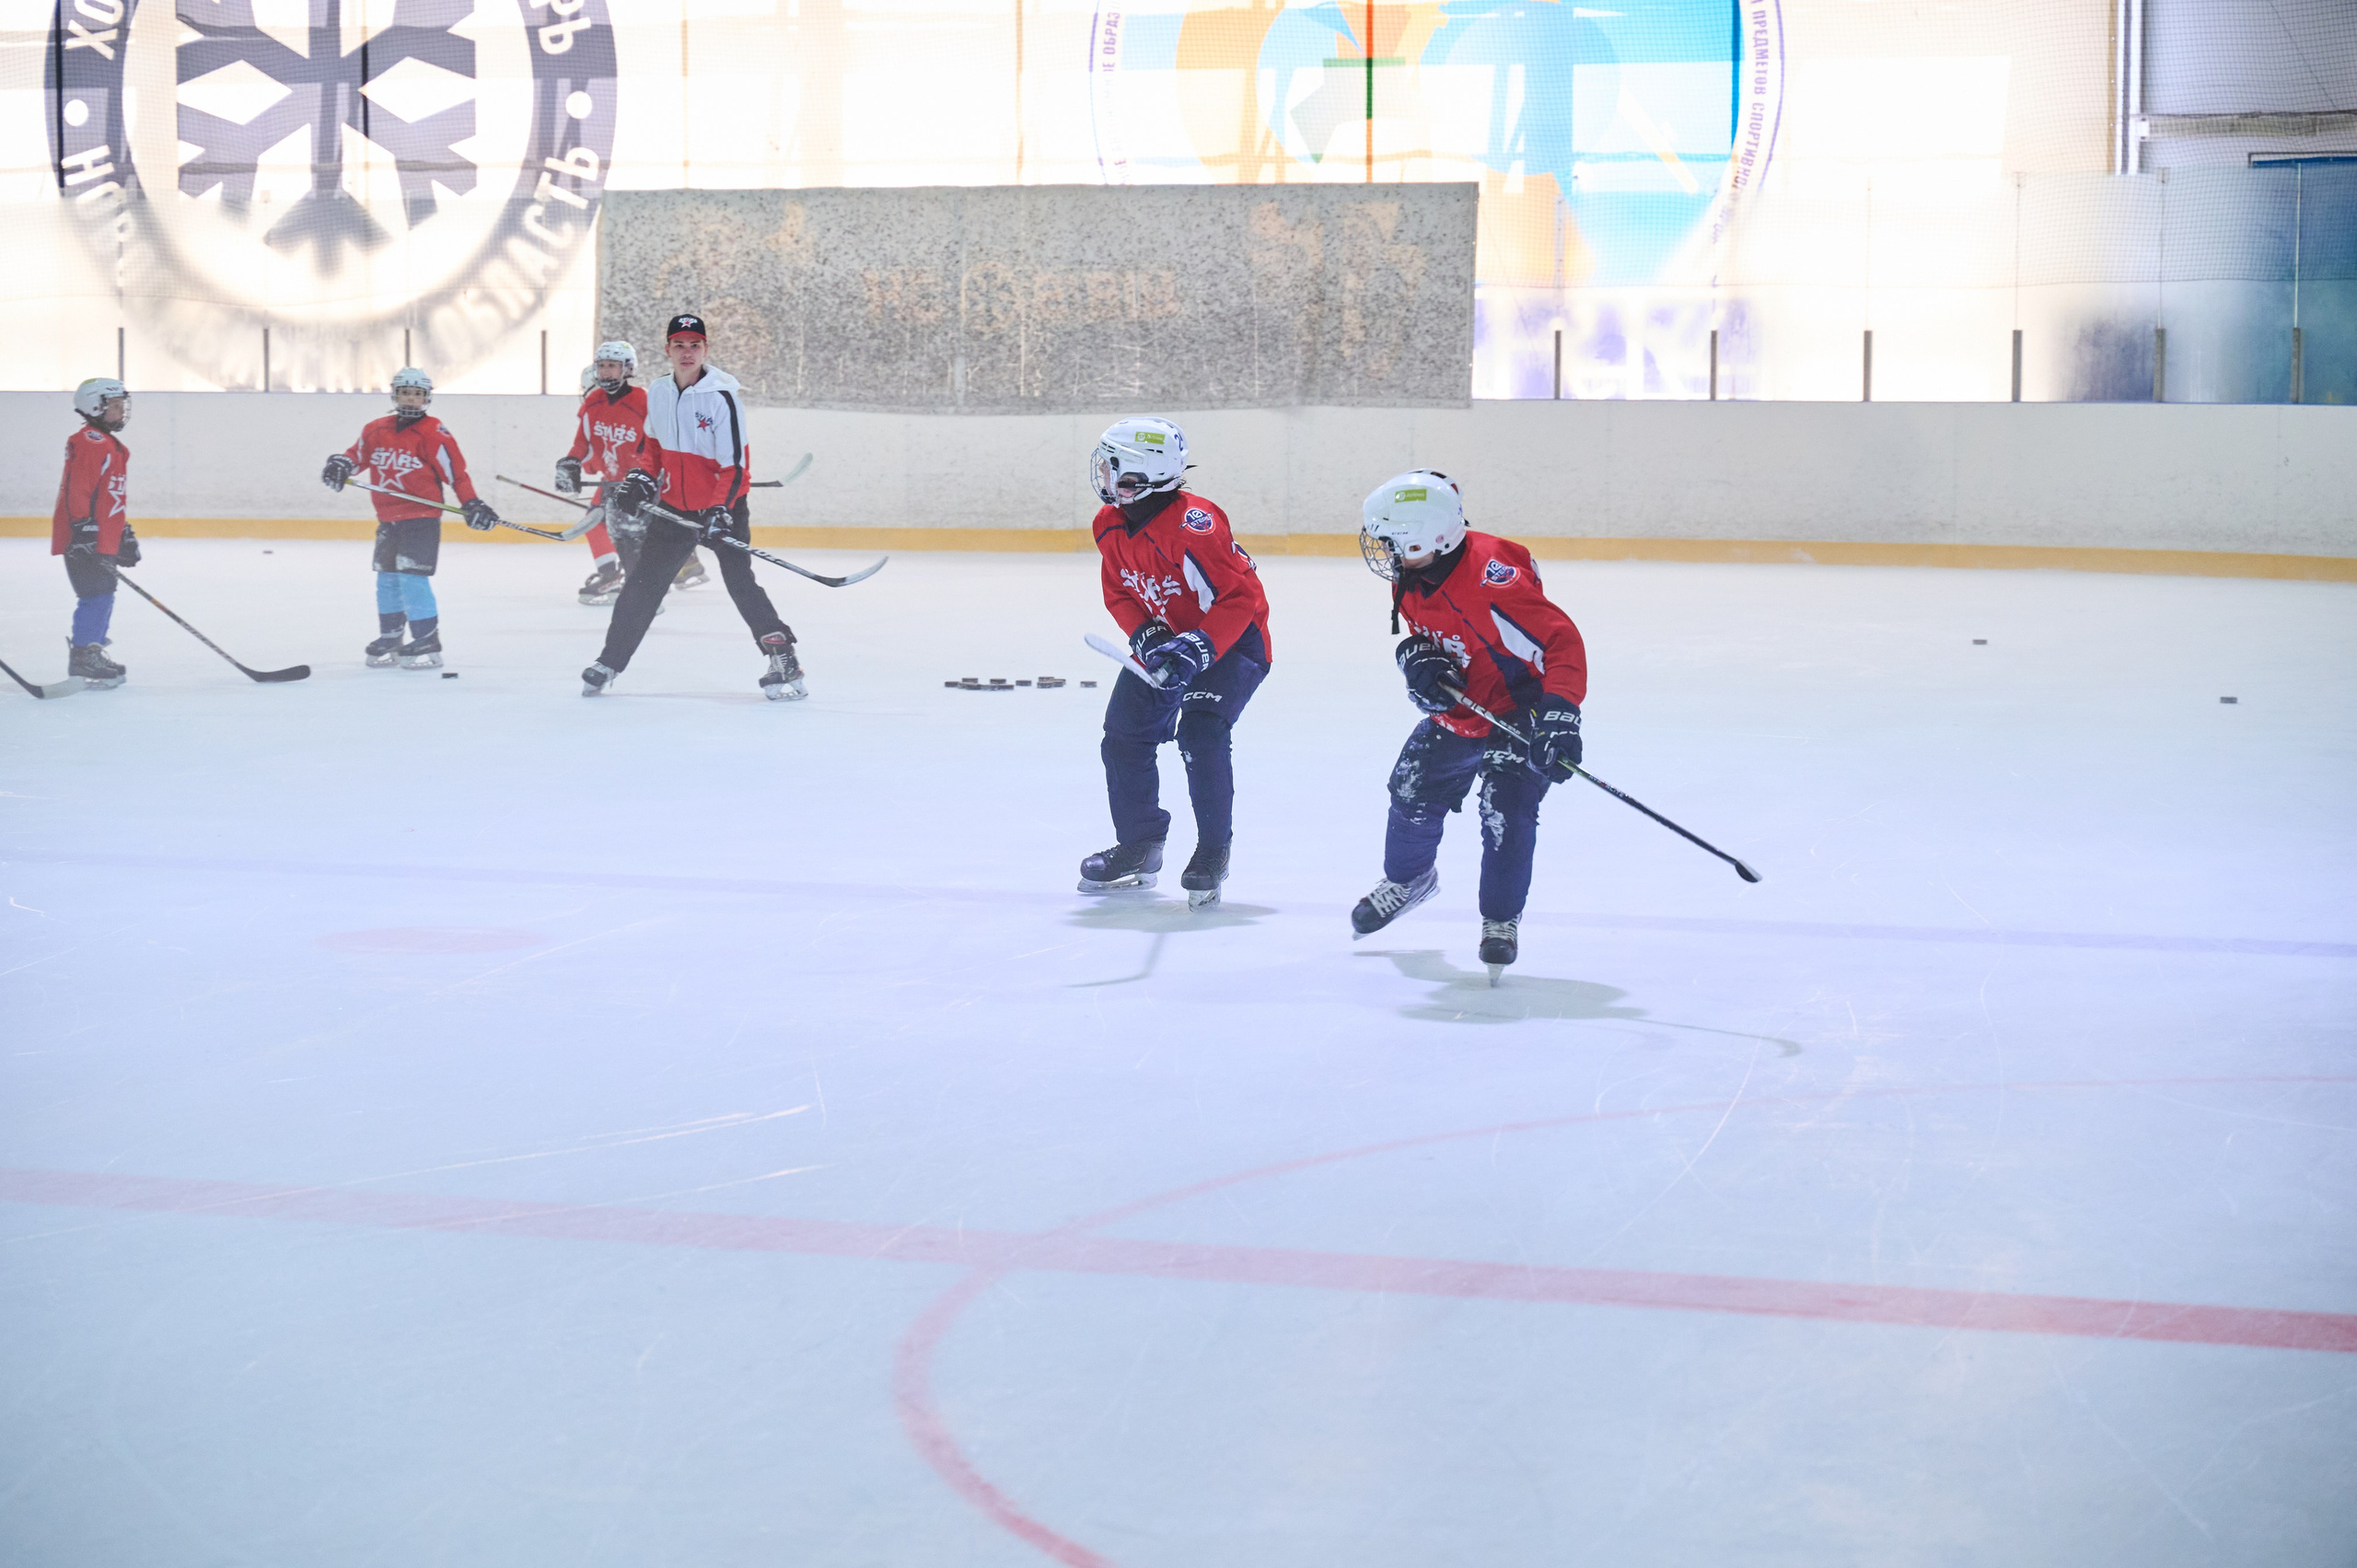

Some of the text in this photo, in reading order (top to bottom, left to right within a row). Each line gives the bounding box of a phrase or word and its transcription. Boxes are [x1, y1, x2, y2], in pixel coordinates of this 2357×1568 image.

[1751, 10, 1769, 95] ПРЕДМЕТОВ
[369, 450, 424, 470] STARS
[1187, 510, 1203, 520] 10
[1182, 691, 1223, 703] CCM
